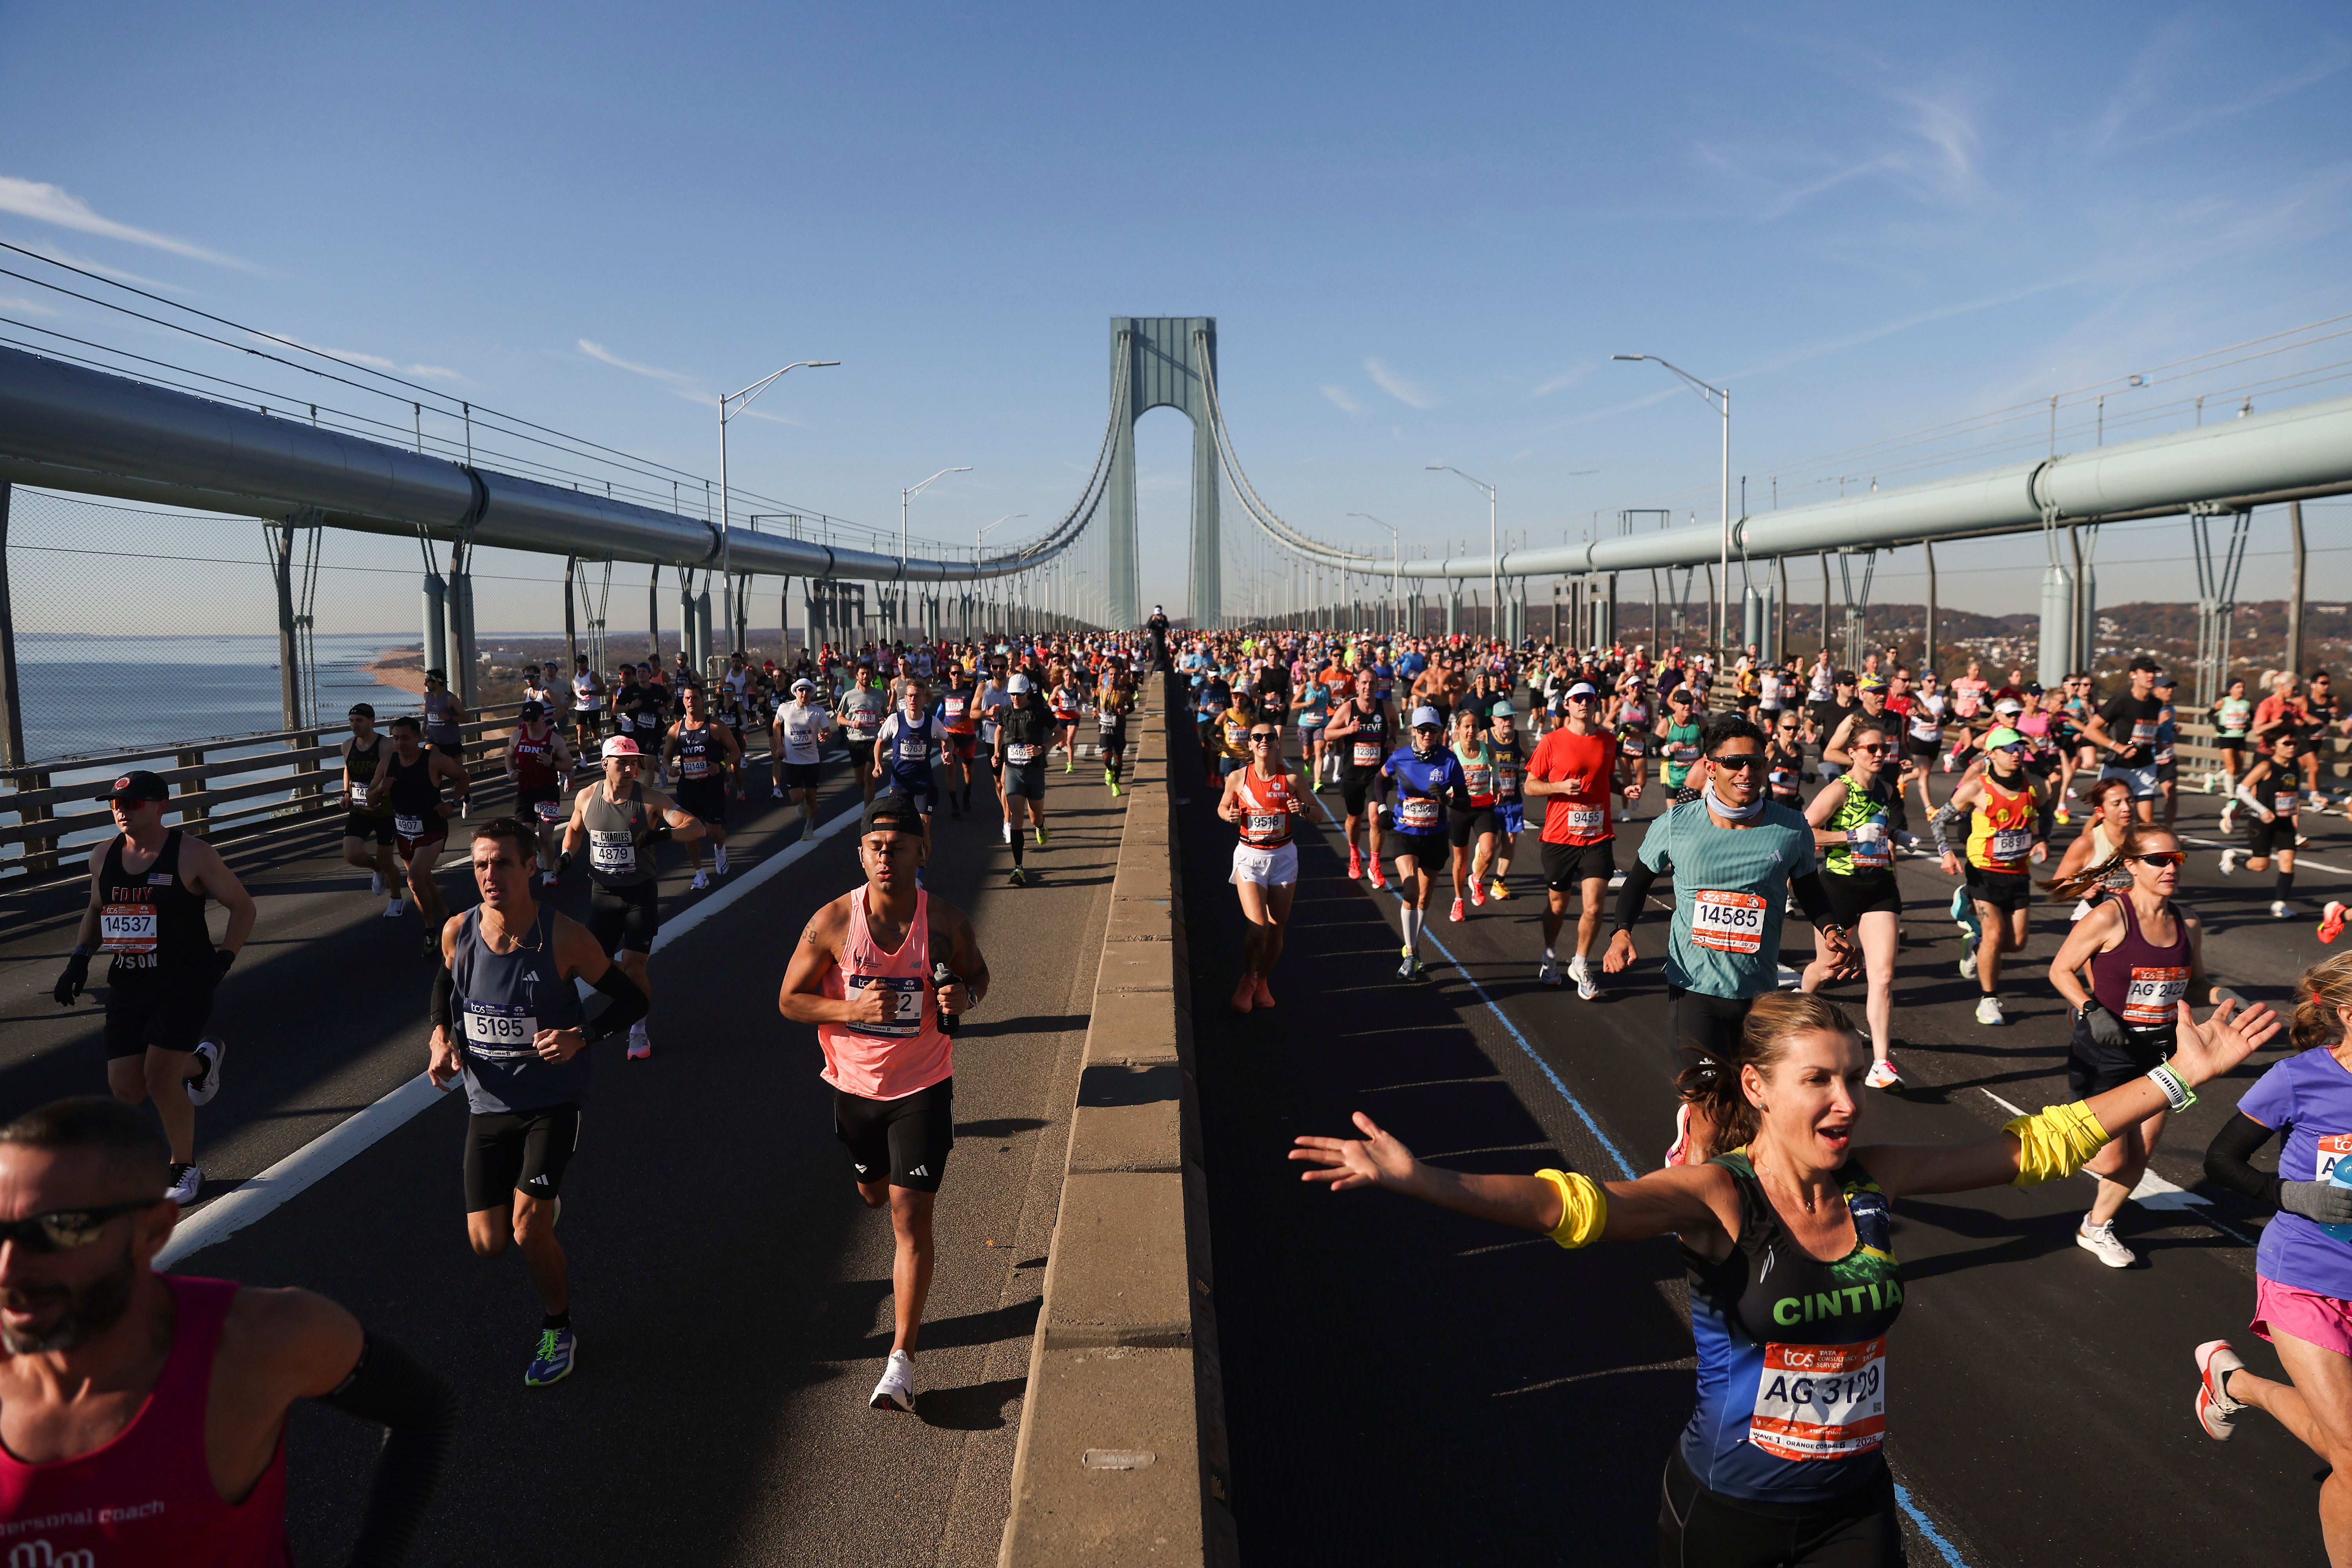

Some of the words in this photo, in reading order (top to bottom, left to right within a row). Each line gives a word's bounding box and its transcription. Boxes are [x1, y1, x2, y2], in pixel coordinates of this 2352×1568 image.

[1359, 723, 1383, 731] STEVE
[685, 762, 705, 770] 22149
[537, 805, 558, 814] 19282
[1254, 816, 1279, 826] 9518
[1574, 812, 1599, 822] 9455
[399, 821, 417, 829] 4907
[601, 832, 629, 842] CHARLES
[2002, 836, 2026, 848] 6891
[599, 848, 628, 859] 4879
[112, 887, 153, 902] FDNY
[1700, 904, 1758, 927] 14585
[105, 916, 151, 932] 14537
[2140, 971, 2156, 979] tcs
[858, 978, 871, 987] tc
[2130, 983, 2154, 996] AG
[2159, 982, 2186, 997] 2422
[471, 1002, 486, 1014] tcs
[477, 1016, 524, 1037] 5195
[2334, 1137, 2352, 1152] tc
[1773, 1279, 1903, 1326] CINTIA
[1784, 1348, 1815, 1367] tcs
[1764, 1375, 1814, 1404] AG
[1822, 1365, 1879, 1405] 3129
[1753, 1431, 1773, 1441] WAVE
[1786, 1440, 1815, 1449] ORANGE
[1855, 1435, 1877, 1448] 2025
[97, 1499, 165, 1524] coach
